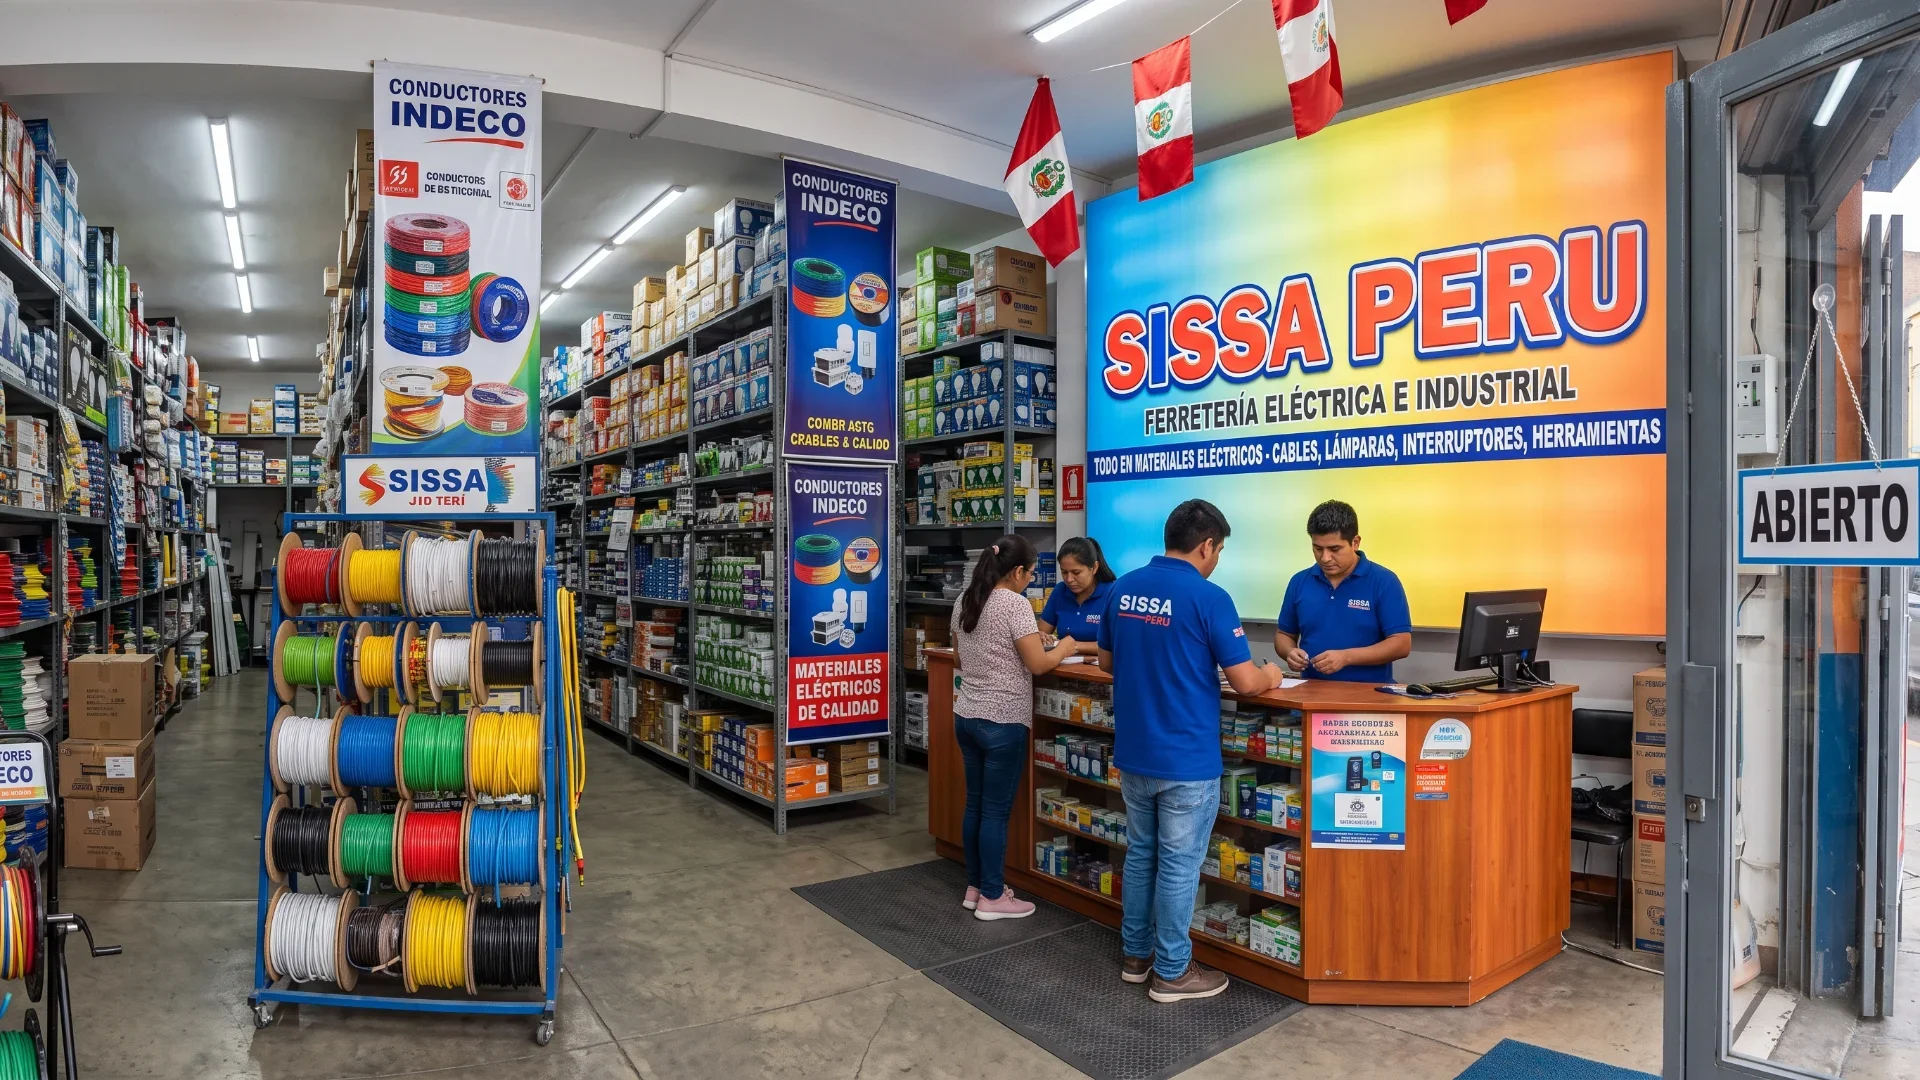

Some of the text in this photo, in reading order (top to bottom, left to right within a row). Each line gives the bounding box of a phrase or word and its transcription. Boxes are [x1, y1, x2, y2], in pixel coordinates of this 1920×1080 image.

[389, 78, 527, 108] CONDUCTORES
[391, 101, 526, 137] INDECO
[426, 171, 486, 185] CONDUCTORS
[792, 173, 888, 205] CONDUCTORES
[801, 192, 881, 225] INDECO
[1103, 221, 1646, 398] SISSA PERU
[1145, 366, 1576, 435] FERRETERÍA ELÉCTRICA E INDUSTRIAL
[807, 417, 846, 431] COMBR
[790, 433, 840, 447] CRABLES
[843, 436, 850, 448] &
[1094, 455, 1118, 476] TODO
[1120, 454, 1133, 474] EN
[1135, 449, 1195, 472] MATERIALES
[1197, 443, 1263, 468] ELÉCTRICOS
[1272, 439, 1322, 466] CABLES,
[1325, 432, 1398, 461] LÁMPARAS,
[1402, 424, 1528, 456] INTERRUPTORES,
[1532, 417, 1661, 449] HERRAMIENTAS
[388, 468, 487, 493] SISSA
[794, 479, 883, 497] CONDUCTORES
[812, 497, 867, 515] INDECO
[1750, 482, 1909, 543] ABIERTO
[1119, 594, 1172, 616] SISSA
[1145, 614, 1171, 627] PERU
[795, 658, 881, 679] MATERIALES
[796, 678, 881, 700] ELÉCTRICOS
[798, 699, 879, 721] DE CALIDAD
